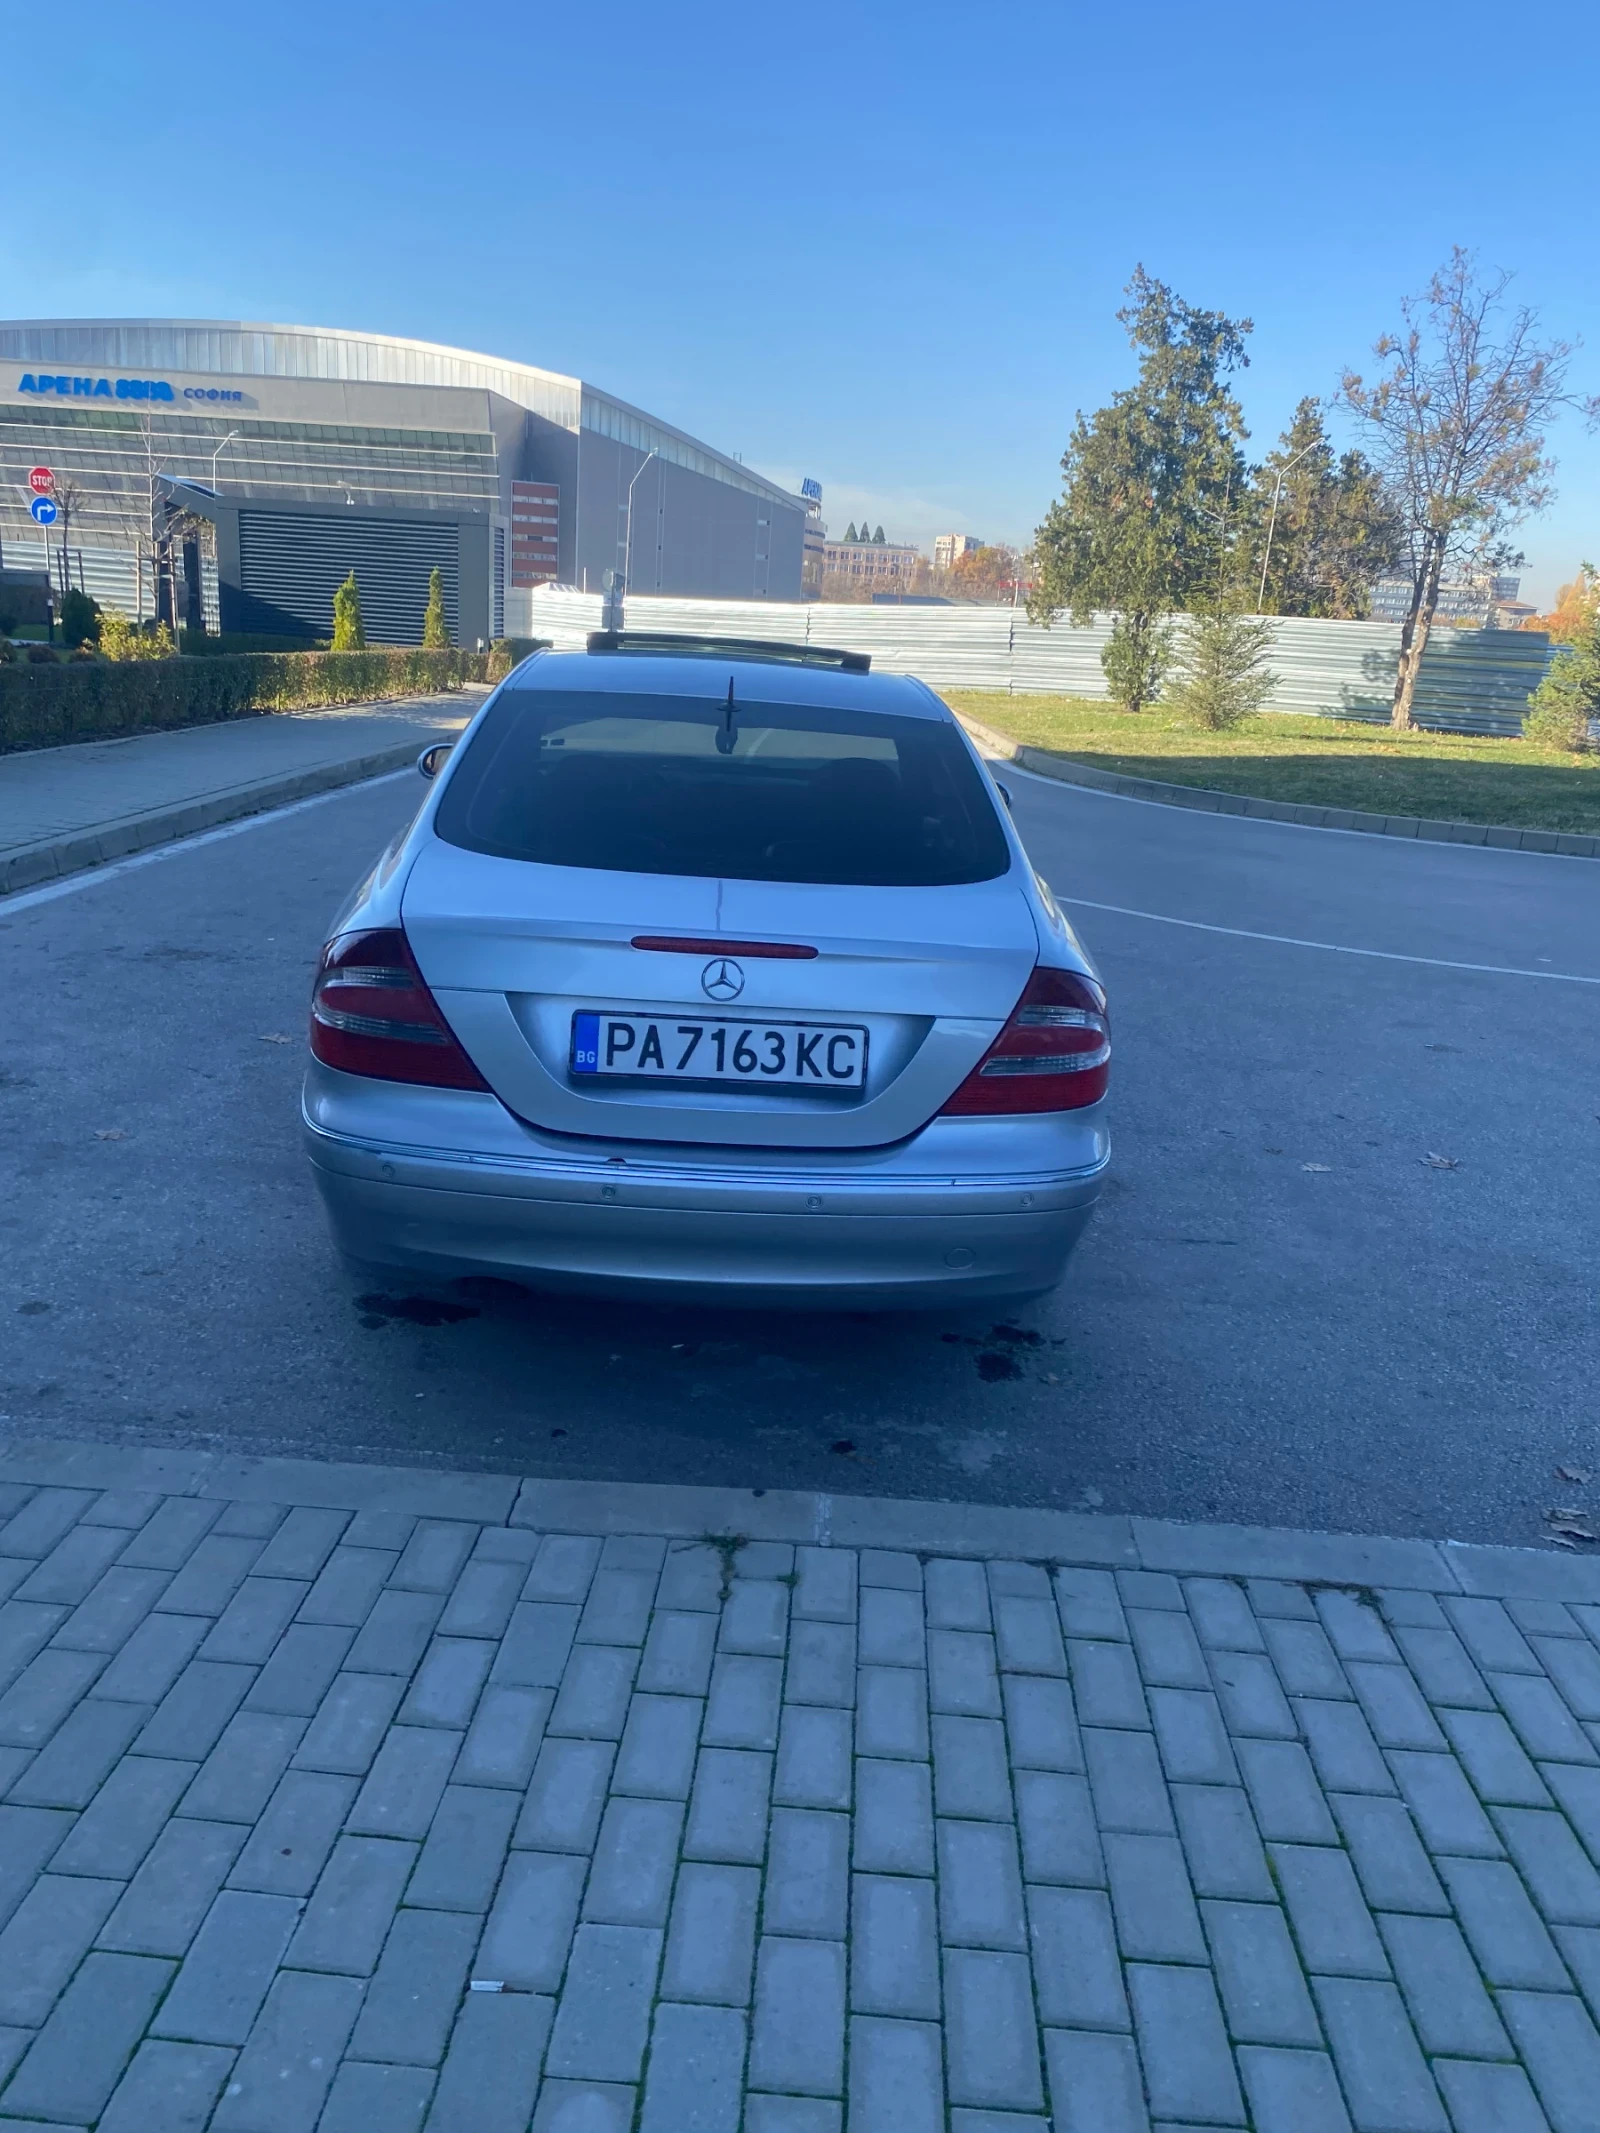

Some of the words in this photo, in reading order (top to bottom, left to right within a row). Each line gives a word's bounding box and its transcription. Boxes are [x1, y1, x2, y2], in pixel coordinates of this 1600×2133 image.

[18, 373, 113, 398] АРЕНА
[183, 387, 242, 402] СОФИЯ
[32, 475, 53, 487] STOP
[576, 1049, 596, 1064] BG
